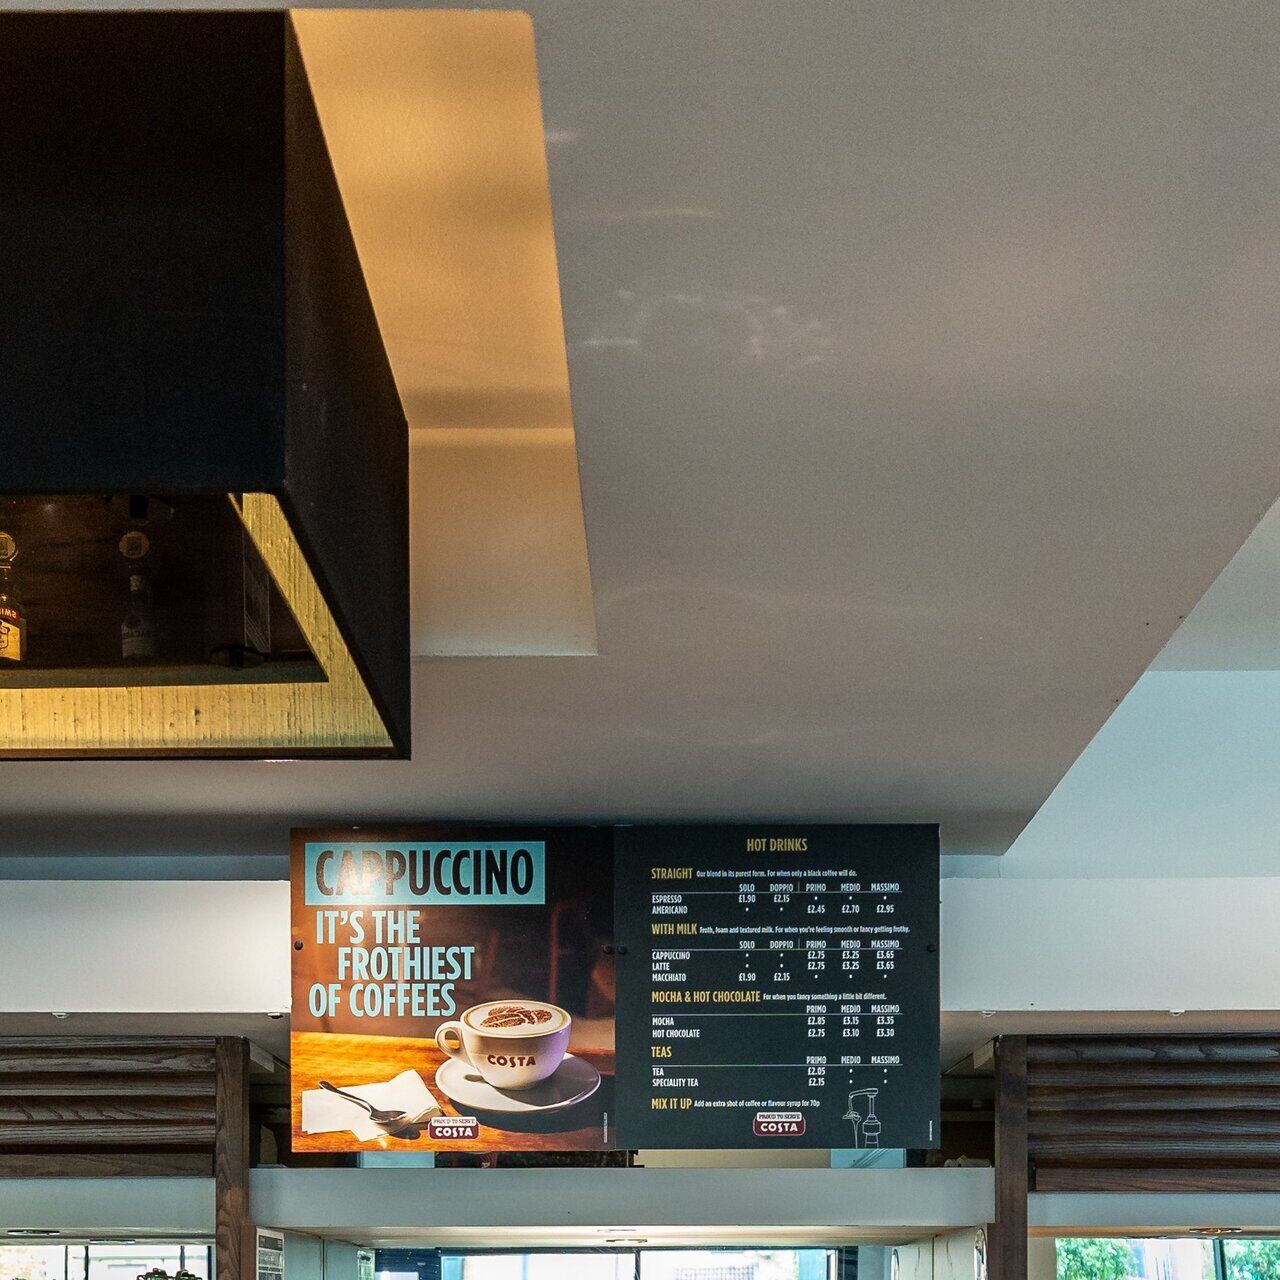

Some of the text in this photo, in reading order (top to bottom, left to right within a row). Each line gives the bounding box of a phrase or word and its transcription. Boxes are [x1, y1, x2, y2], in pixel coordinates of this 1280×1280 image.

[747, 838, 808, 852] HOT DRINKS
[315, 848, 534, 896] CAPPUCCINO
[651, 868, 693, 879] STRAIGHT
[739, 883, 900, 892] SOLO DOPPIO PRIMO MEDIO MASSIMO
[652, 894, 790, 903] ESPRESSO £1.90 £2.15
[652, 905, 894, 914] AMERICANO £2.45 £2.70 £2.95
[371, 910, 421, 944] THE
[651, 923, 697, 934] WITH MILK
[739, 940, 900, 949] SOLO DOPPIO PRIMO MEDIO MASSIMO
[652, 950, 894, 960] CAPPUCCINO £2.75 £3.25 £3.65
[338, 946, 475, 980] FROTHIEST
[652, 961, 894, 971] LATTE £2.75 £3.25 £3.65
[652, 973, 790, 982] MACCHIATO £1.90 £2.15
[308, 983, 456, 1017] OF COFFEES
[651, 990, 761, 1003] MOCHA & HOT CHOCOLATE
[806, 1004, 900, 1014] PRIMO MEDIO MASSIMO
[652, 1016, 894, 1026] MOCHA £2.85 £3.15 £3.35
[652, 1029, 894, 1038] HOT CHOCOLATE £2.75 £3.10 £3.30
[651, 1046, 672, 1058] TEAS
[487, 1054, 537, 1069] COSTA
[806, 1056, 900, 1064] PRIMO MEDIO MASSIMO
[652, 1067, 826, 1076] TEA £2.05
[652, 1077, 826, 1087] SPECIALITY TEA £2.15
[651, 1098, 692, 1109] MIX IT UP
[435, 1127, 473, 1137] COSTA
[760, 1122, 798, 1132] COSTA
